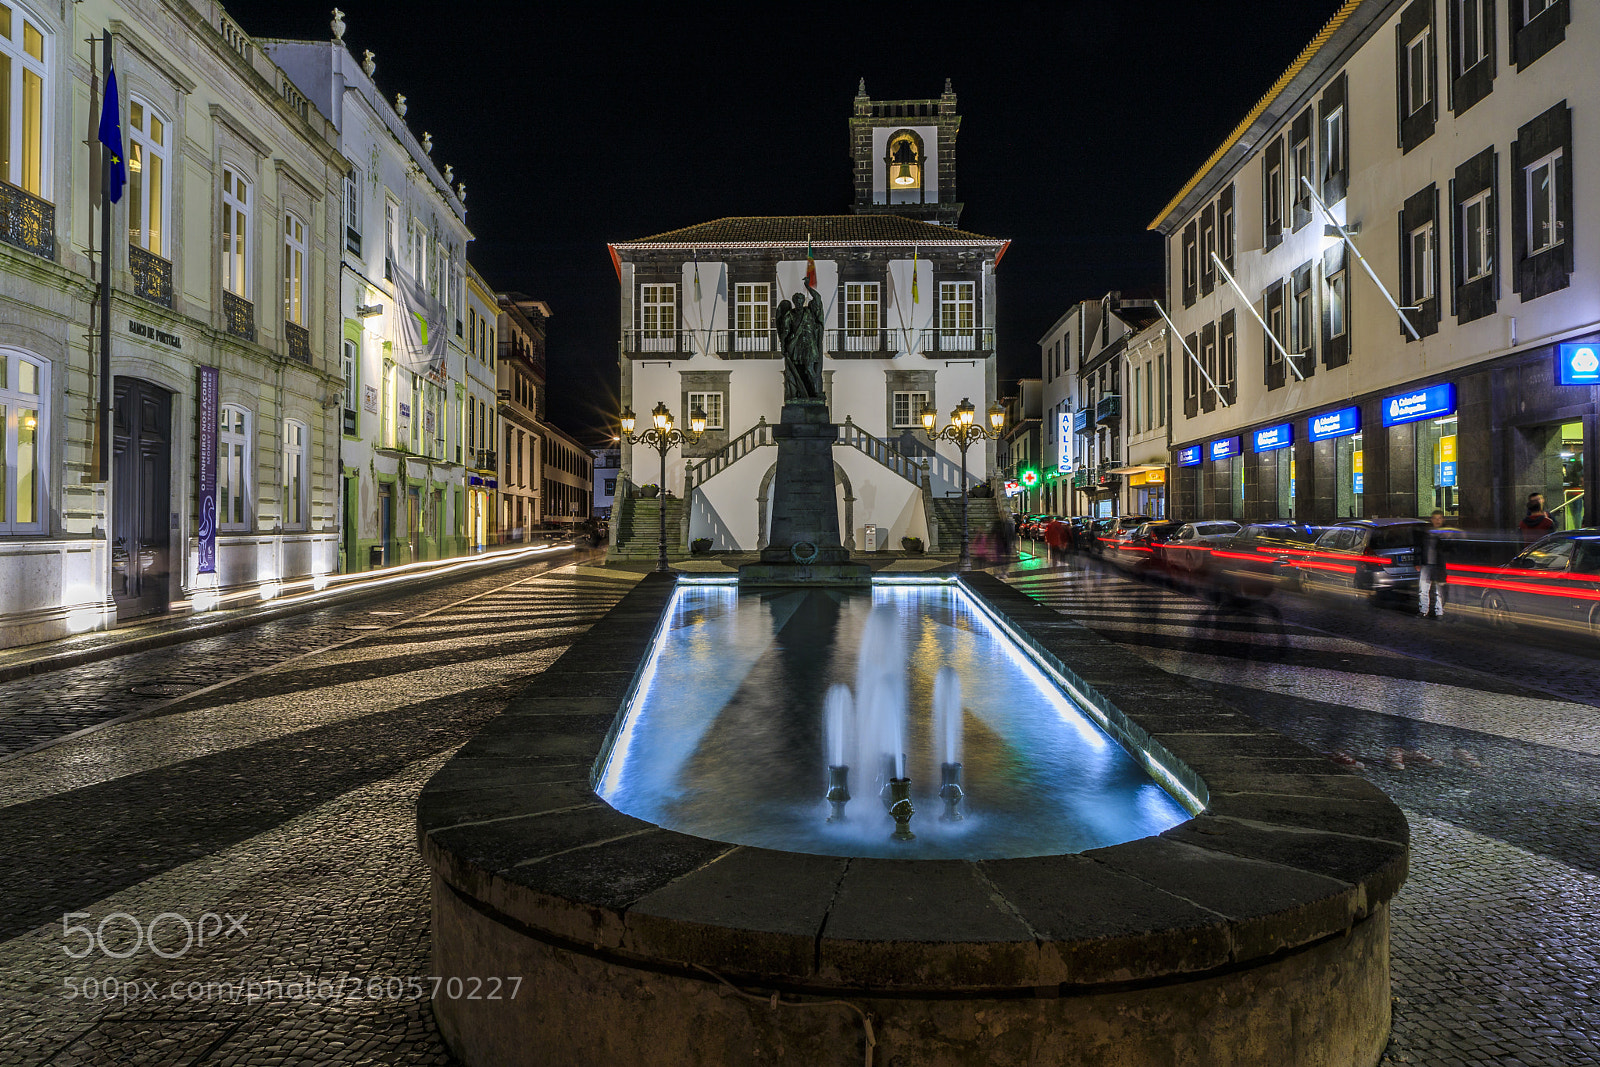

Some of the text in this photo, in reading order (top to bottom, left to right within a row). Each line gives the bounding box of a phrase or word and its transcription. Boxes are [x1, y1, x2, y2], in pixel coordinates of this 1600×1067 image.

[129, 320, 181, 349] BANCO DE PORTUGAL
[207, 423, 212, 432] IN
[1062, 415, 1070, 463] AVLIS
[201, 483, 206, 491] O
